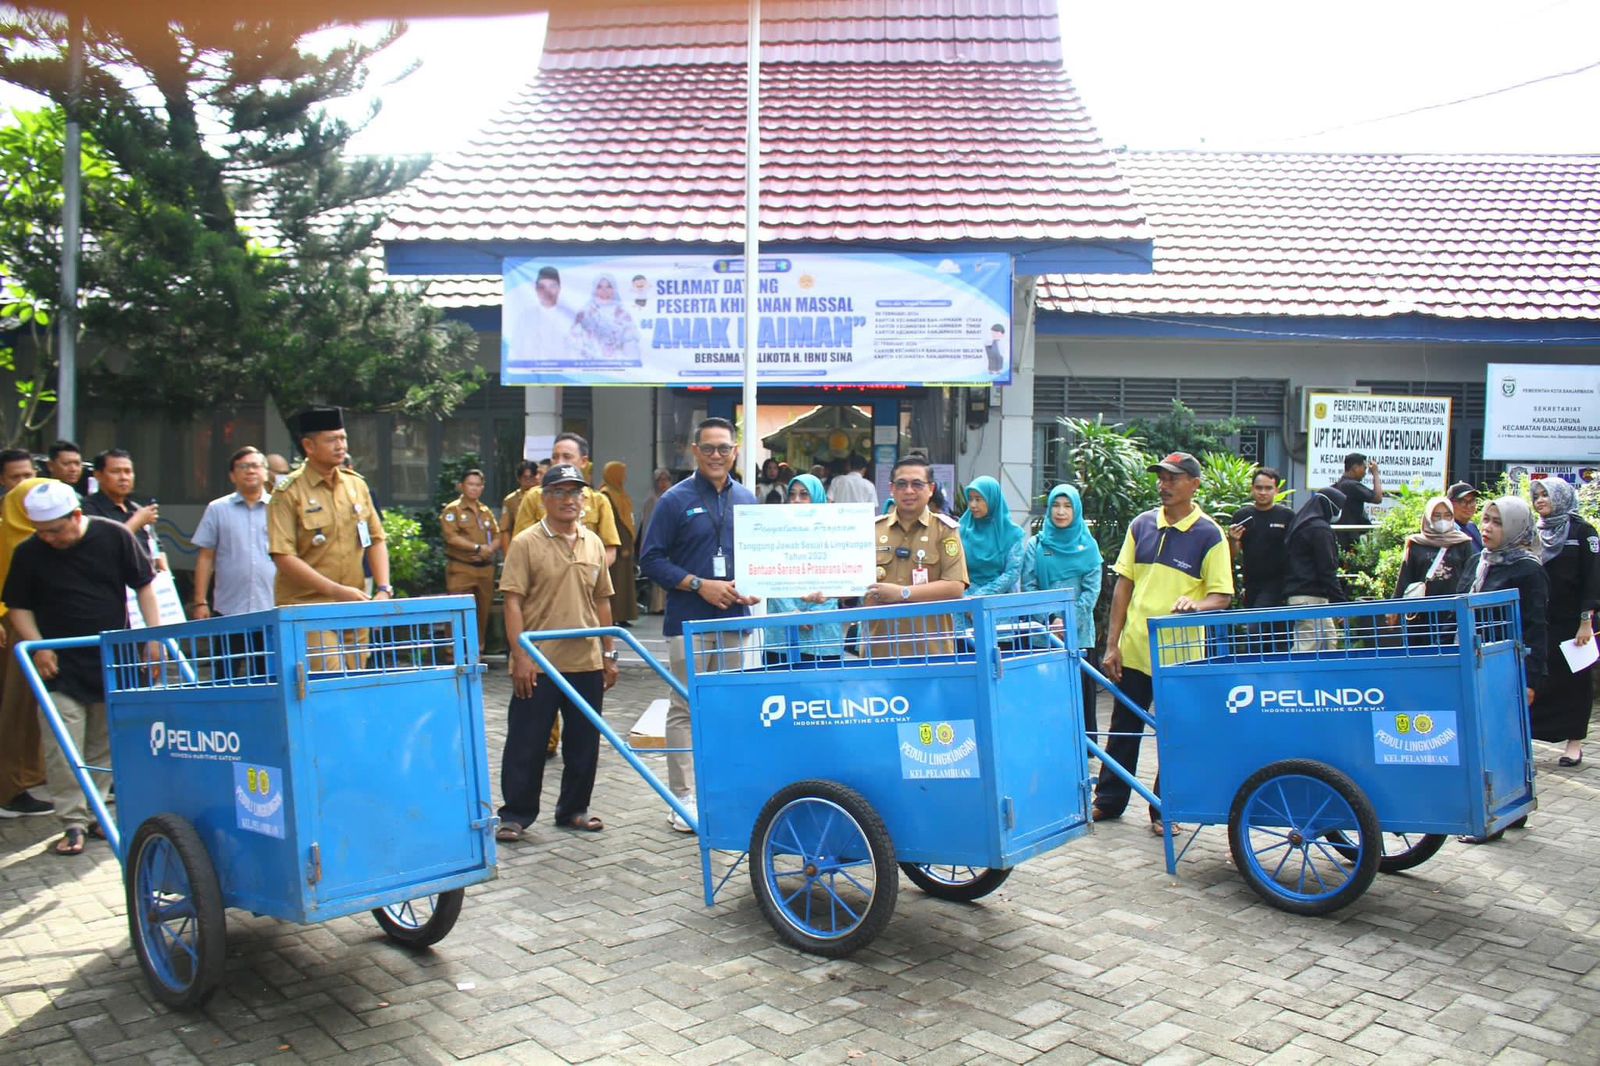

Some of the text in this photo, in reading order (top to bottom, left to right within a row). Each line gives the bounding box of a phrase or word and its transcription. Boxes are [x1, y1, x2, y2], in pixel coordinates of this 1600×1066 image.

[656, 278, 778, 295] SELAMAT DANG
[656, 298, 717, 314] PESERTA
[796, 296, 854, 312] MASSAL
[694, 352, 852, 364] BERSAMA LIKOTA H. IBNU SINA
[1334, 400, 1446, 414] PEMERINTAH KOTA BANJARMASIN
[1332, 414, 1445, 426] DINAS KEPENDUDUKAN DAN PENCATATAN SIPIL
[1314, 428, 1443, 451] UPT PELAYANAN KEPENDUDUKAN
[1412, 457, 1434, 466] BARAT
[738, 542, 774, 552] Tanggung
[748, 563, 776, 575] Bantuan
[1260, 688, 1384, 707] PELINDO
[792, 696, 909, 720] PELINDO
[168, 729, 240, 753] PELINDO
[1375, 728, 1456, 752] PEDULI LINGKUNGAN
[900, 736, 976, 766] PEDULI LINGKUNGAN
